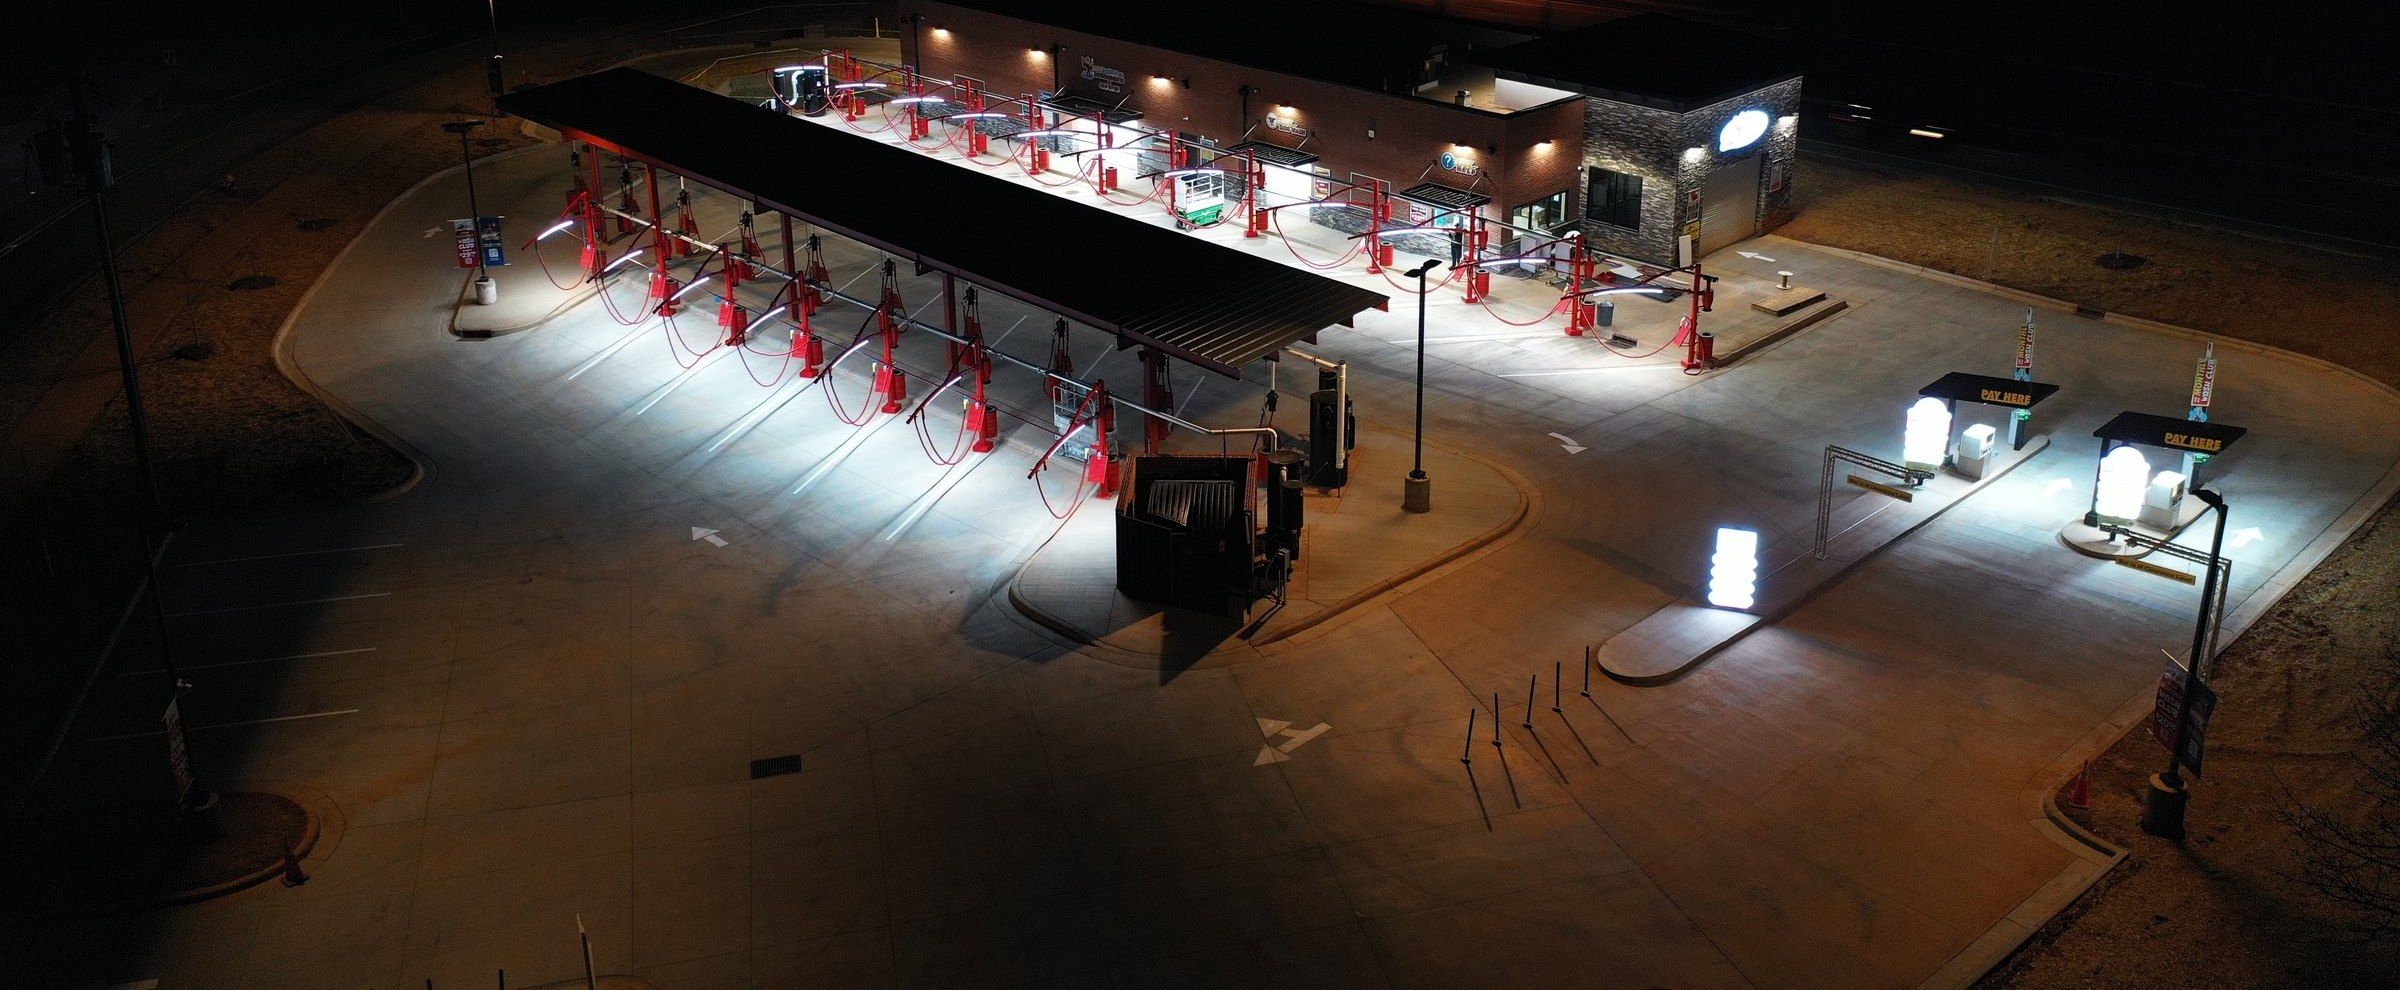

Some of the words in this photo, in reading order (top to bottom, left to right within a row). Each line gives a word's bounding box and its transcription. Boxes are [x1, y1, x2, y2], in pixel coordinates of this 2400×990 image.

[2194, 358, 2206, 396] MONTHLY
[2205, 358, 2215, 380] CLUB
[1981, 389, 2001, 402] PAY
[2003, 392, 2032, 406] HERE
[2164, 432, 2188, 446] PAY
[2189, 436, 2222, 452] HERE
[2144, 565, 2176, 579] Clearance
